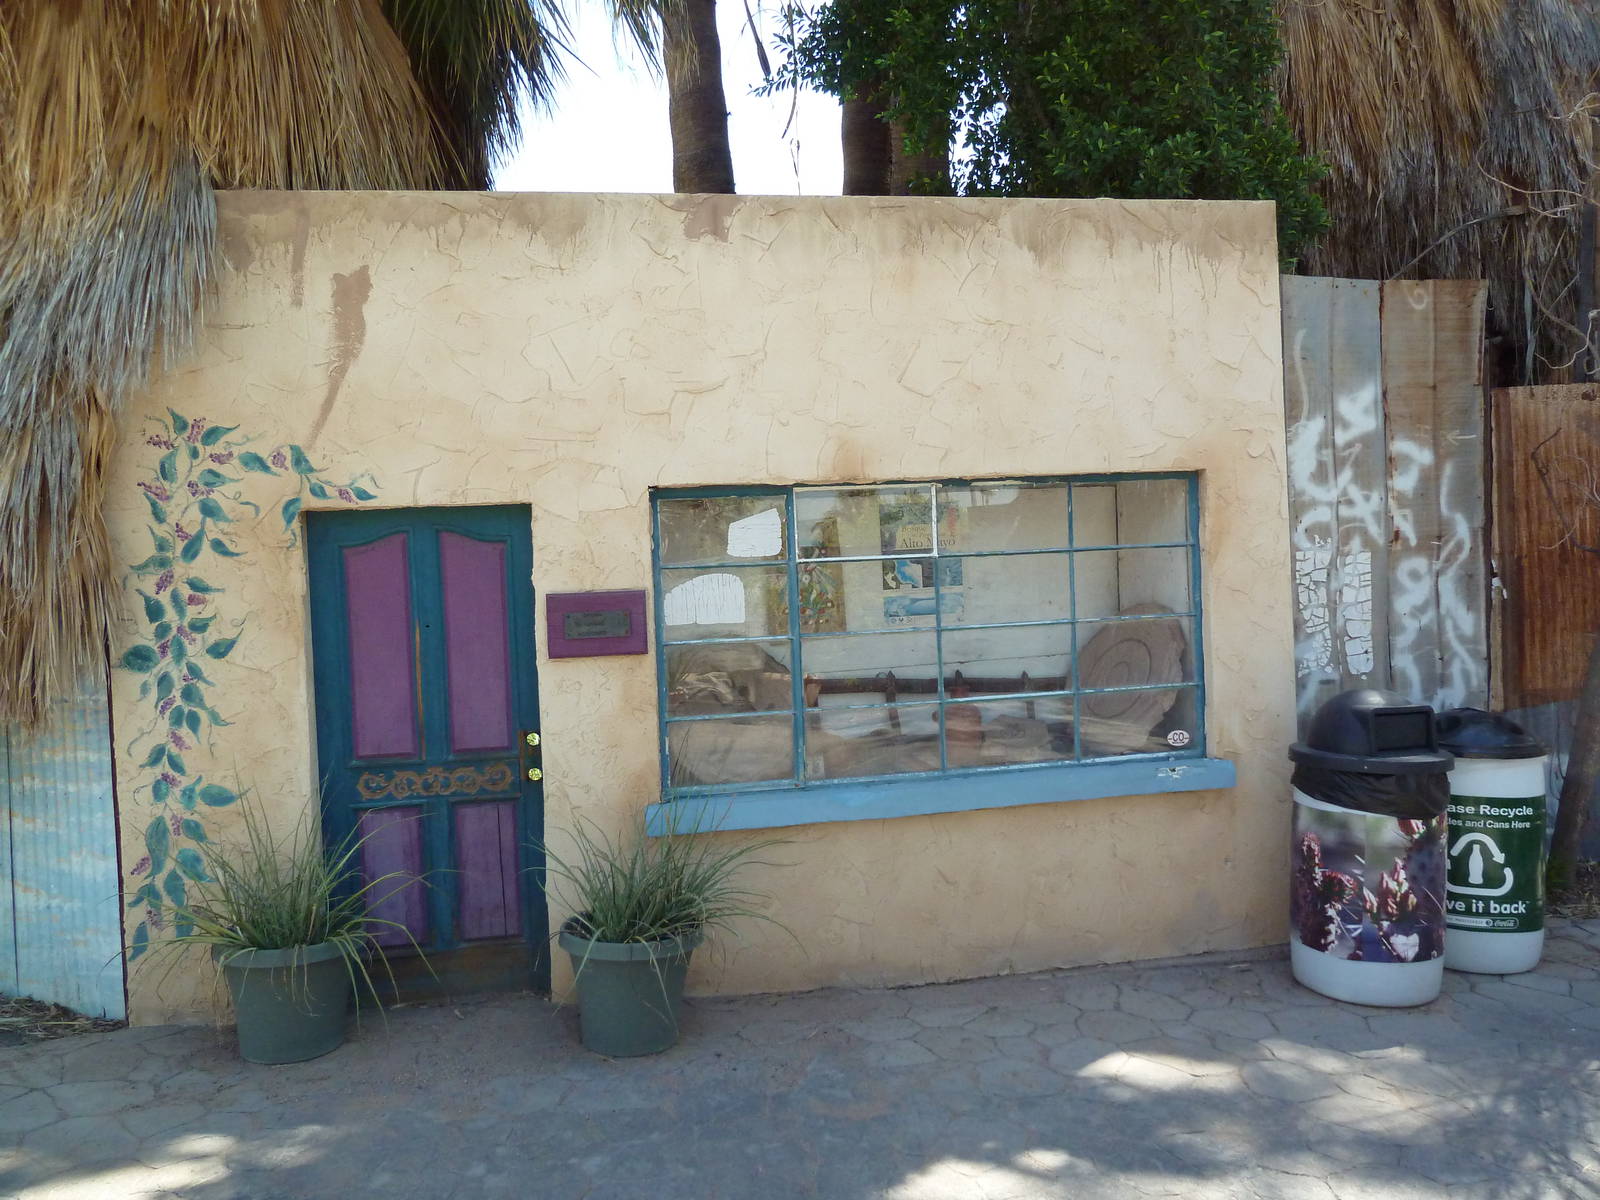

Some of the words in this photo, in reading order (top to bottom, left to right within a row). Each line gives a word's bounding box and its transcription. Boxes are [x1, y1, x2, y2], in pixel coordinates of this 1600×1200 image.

[1479, 804, 1534, 818] Recycle
[1465, 820, 1484, 828] and
[1486, 820, 1510, 829] Cans
[1511, 820, 1531, 829] Here
[1471, 899, 1485, 913] it
[1489, 899, 1526, 914] back
